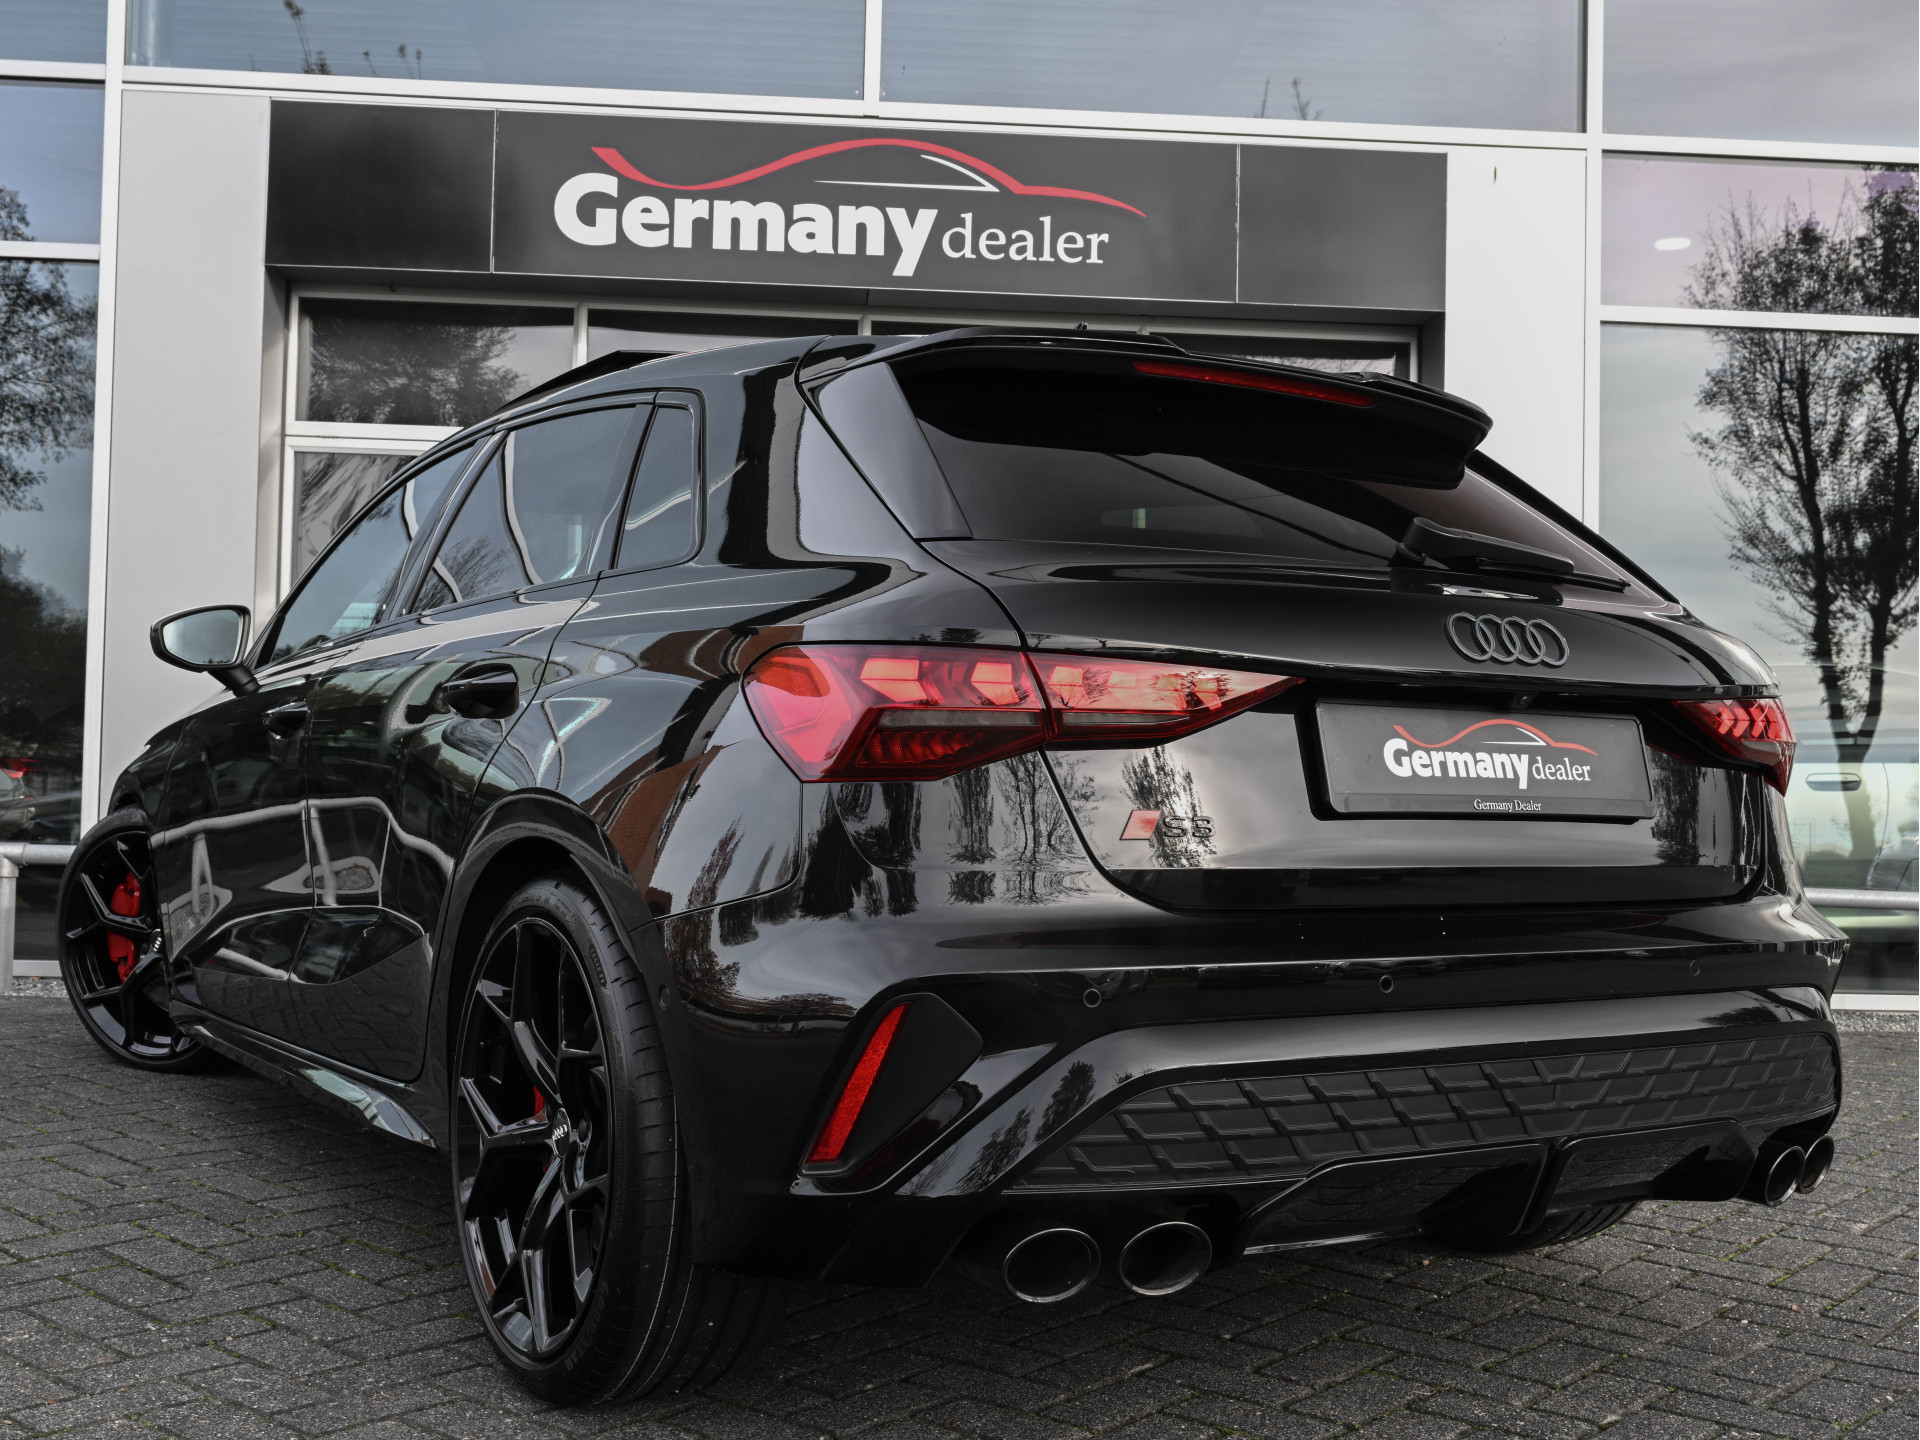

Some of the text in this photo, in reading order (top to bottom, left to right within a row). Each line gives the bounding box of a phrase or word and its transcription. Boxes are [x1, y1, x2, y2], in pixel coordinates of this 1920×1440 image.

[553, 172, 1110, 277] Germany dealer
[1383, 737, 1592, 790] Germany dealer
[1163, 815, 1217, 838] S3
[1473, 798, 1542, 813] Germany Dealer
[564, 1280, 609, 1372] GOODYEAR
